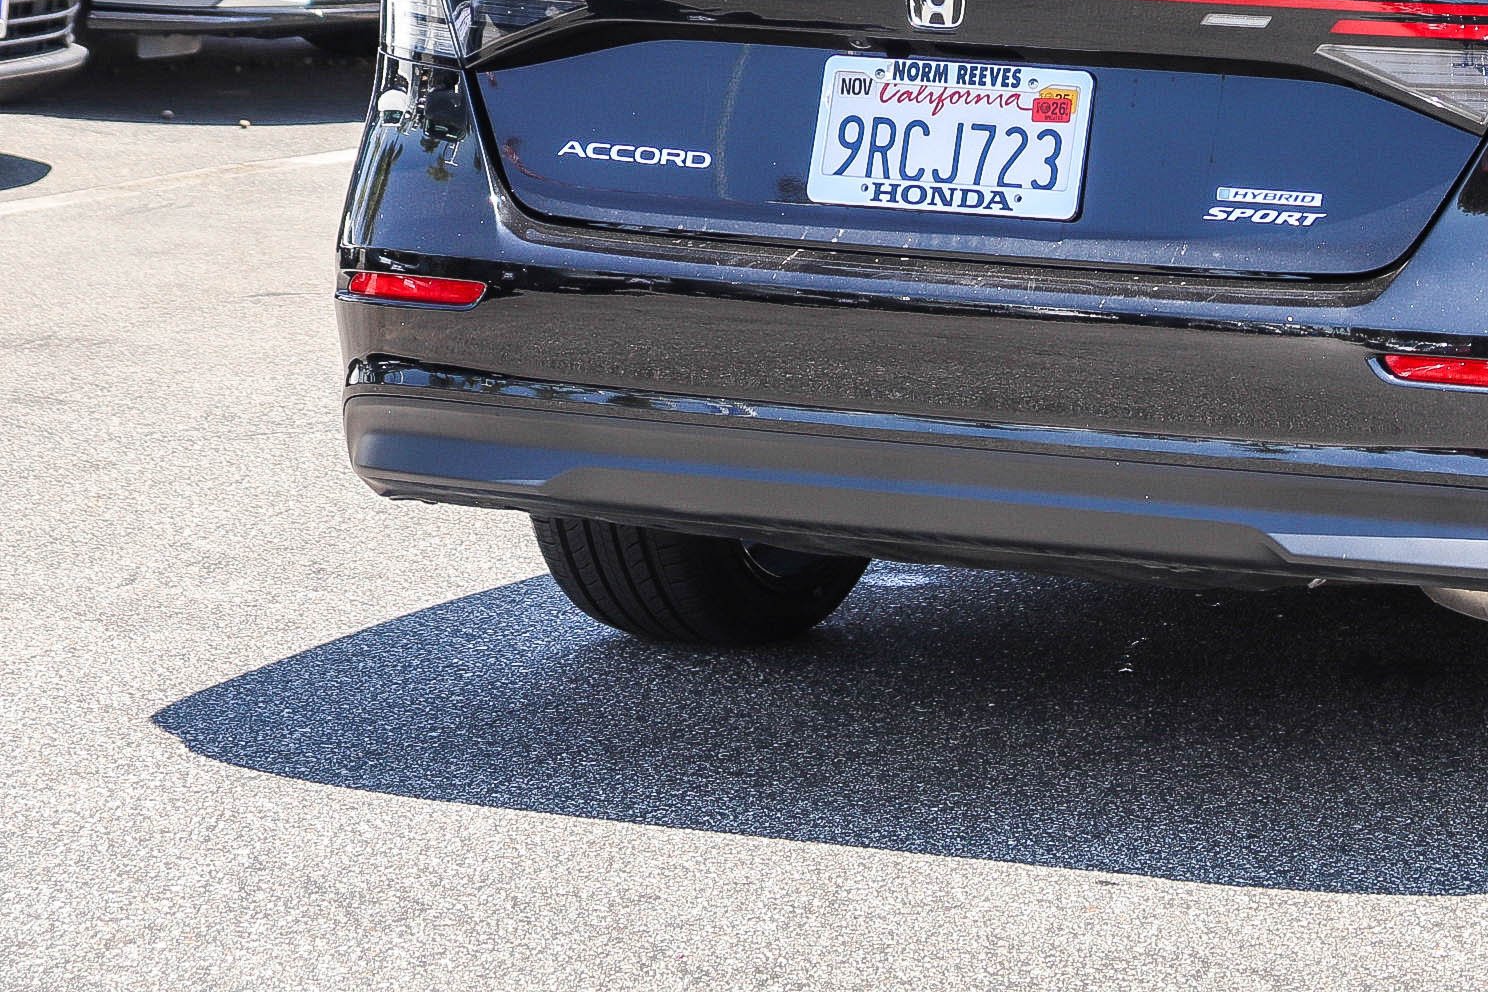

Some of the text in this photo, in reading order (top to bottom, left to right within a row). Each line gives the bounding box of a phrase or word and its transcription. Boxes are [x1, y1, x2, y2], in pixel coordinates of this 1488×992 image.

[840, 77, 873, 96] NOV
[893, 61, 1022, 88] NORM REEVES
[879, 83, 1033, 116] California
[557, 140, 712, 169] ACCORD
[833, 115, 1063, 190] 9RCJ723
[869, 182, 1014, 211] HONDA
[1233, 191, 1315, 203] HYBRID
[1203, 207, 1327, 226] SPORT
